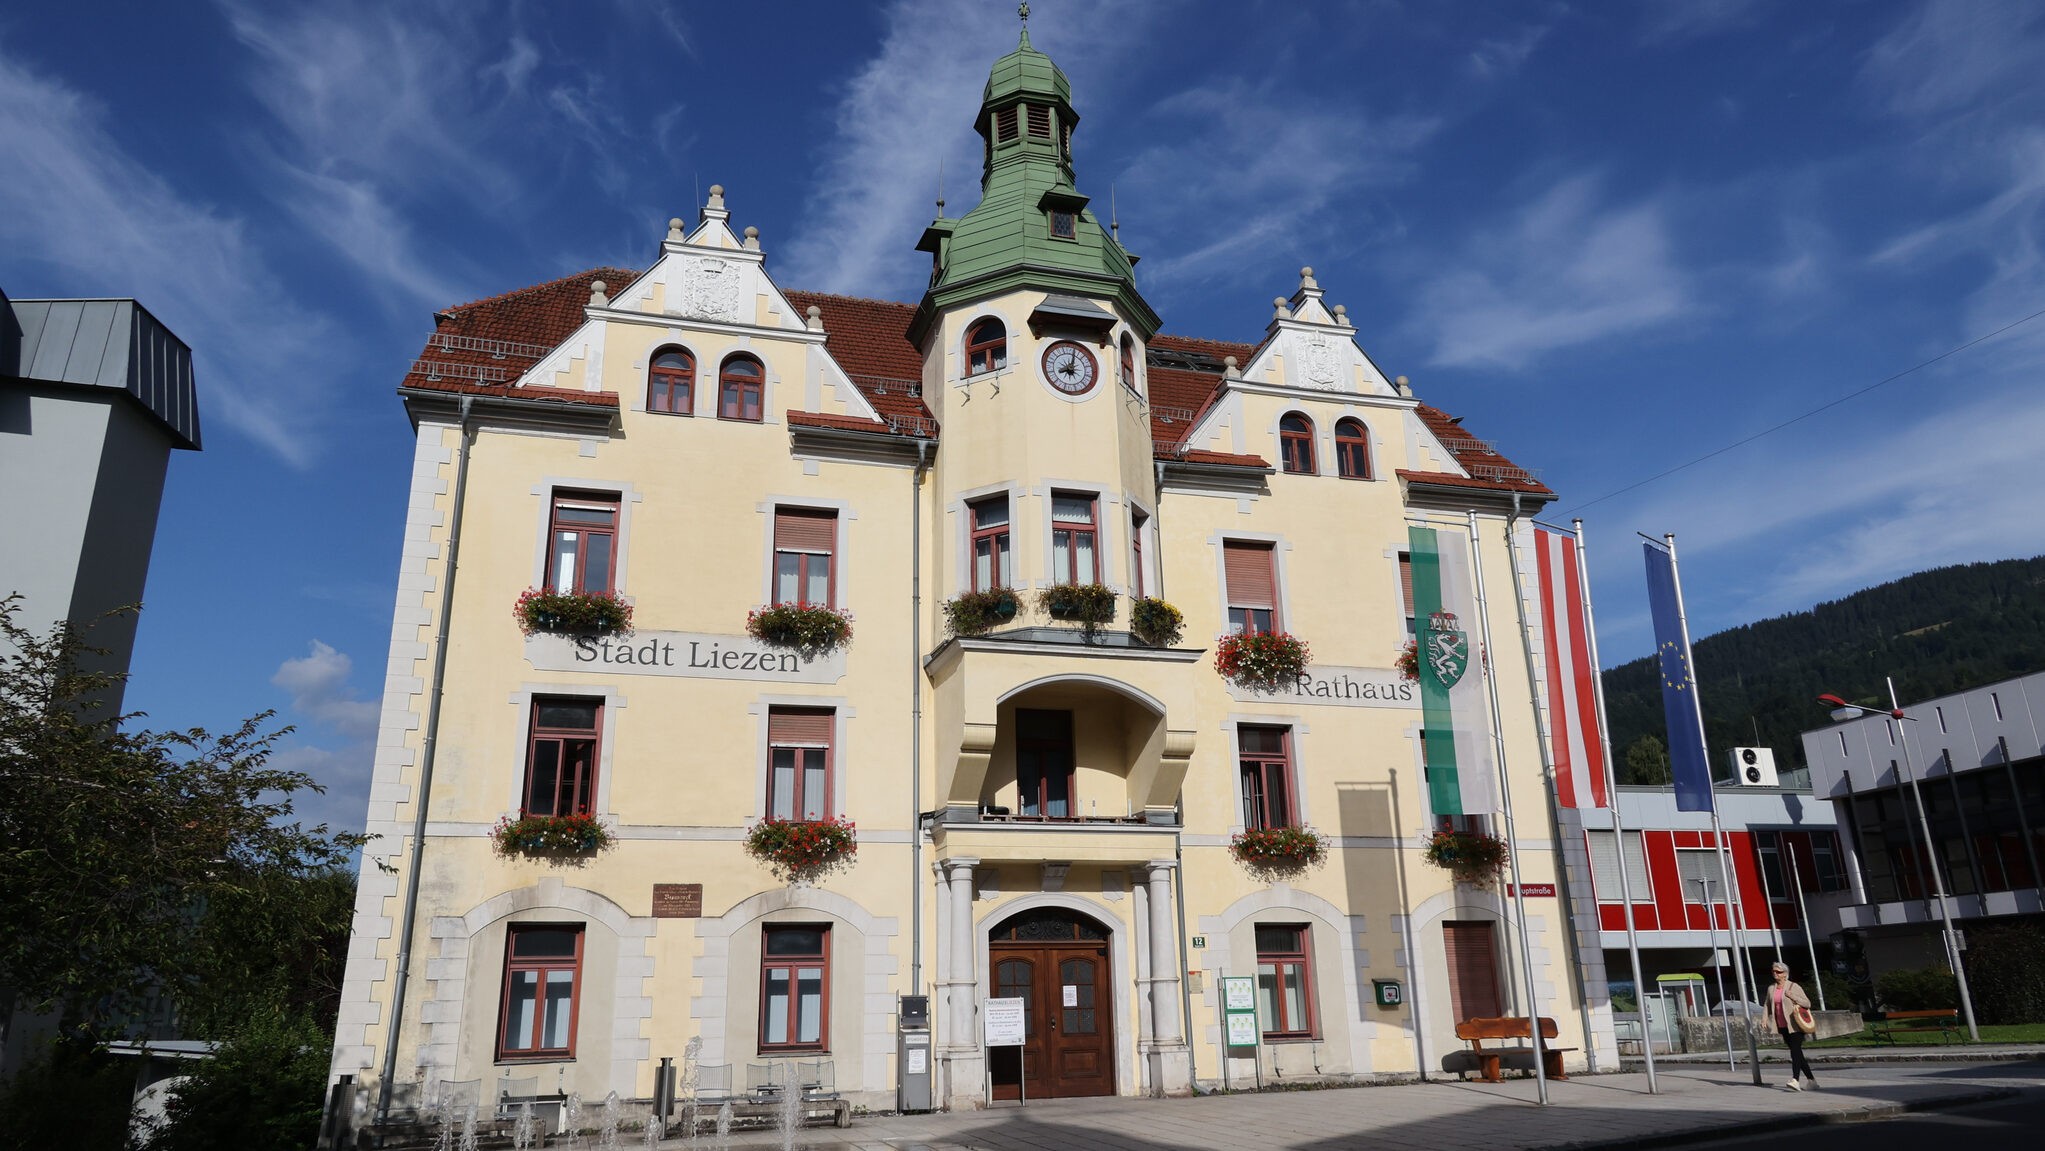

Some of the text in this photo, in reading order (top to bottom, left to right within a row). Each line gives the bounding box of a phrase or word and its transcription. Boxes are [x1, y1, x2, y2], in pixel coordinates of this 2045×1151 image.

[575, 635, 800, 672] Stadt Liezen
[1295, 673, 1412, 701] Rathaus
[1512, 886, 1551, 896] uptstraße
